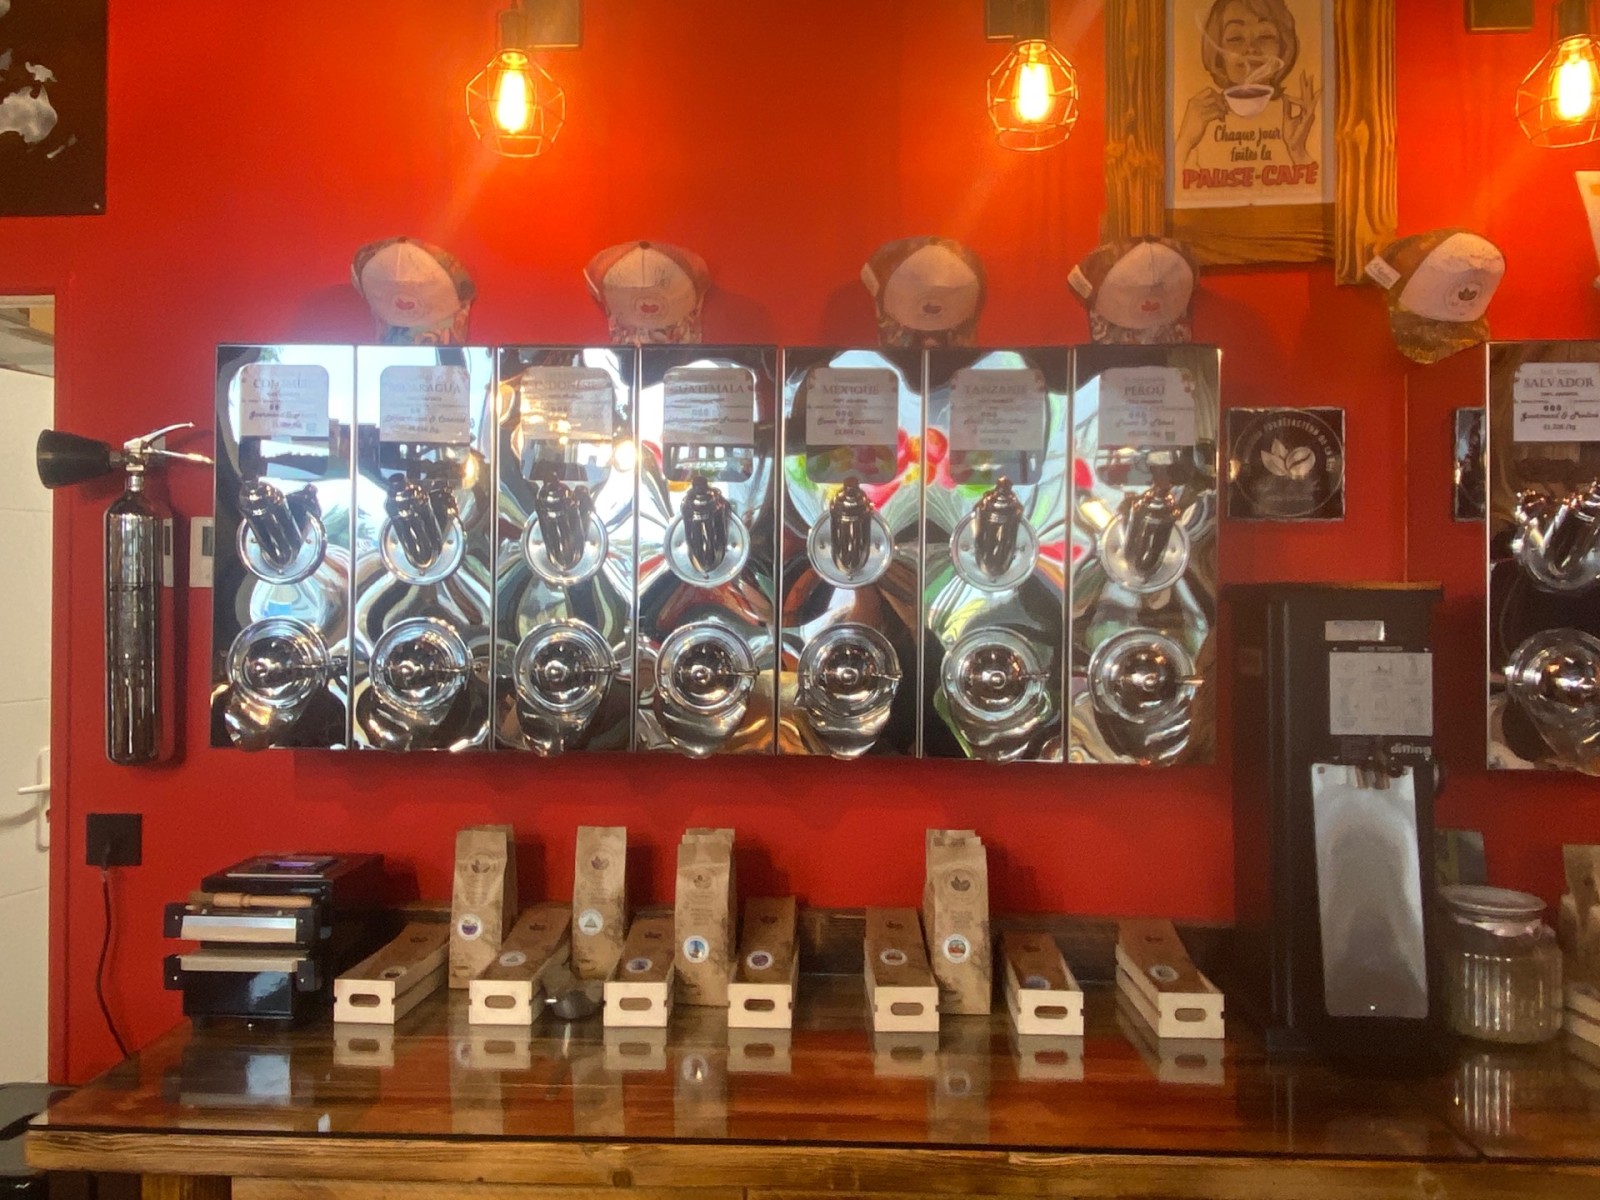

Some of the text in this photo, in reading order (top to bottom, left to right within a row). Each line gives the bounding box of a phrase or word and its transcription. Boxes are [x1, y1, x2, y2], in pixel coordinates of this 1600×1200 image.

[1214, 125, 1281, 146] Chaque jour
[1230, 145, 1272, 162] faites la
[1523, 377, 1594, 388] SALVADOR
